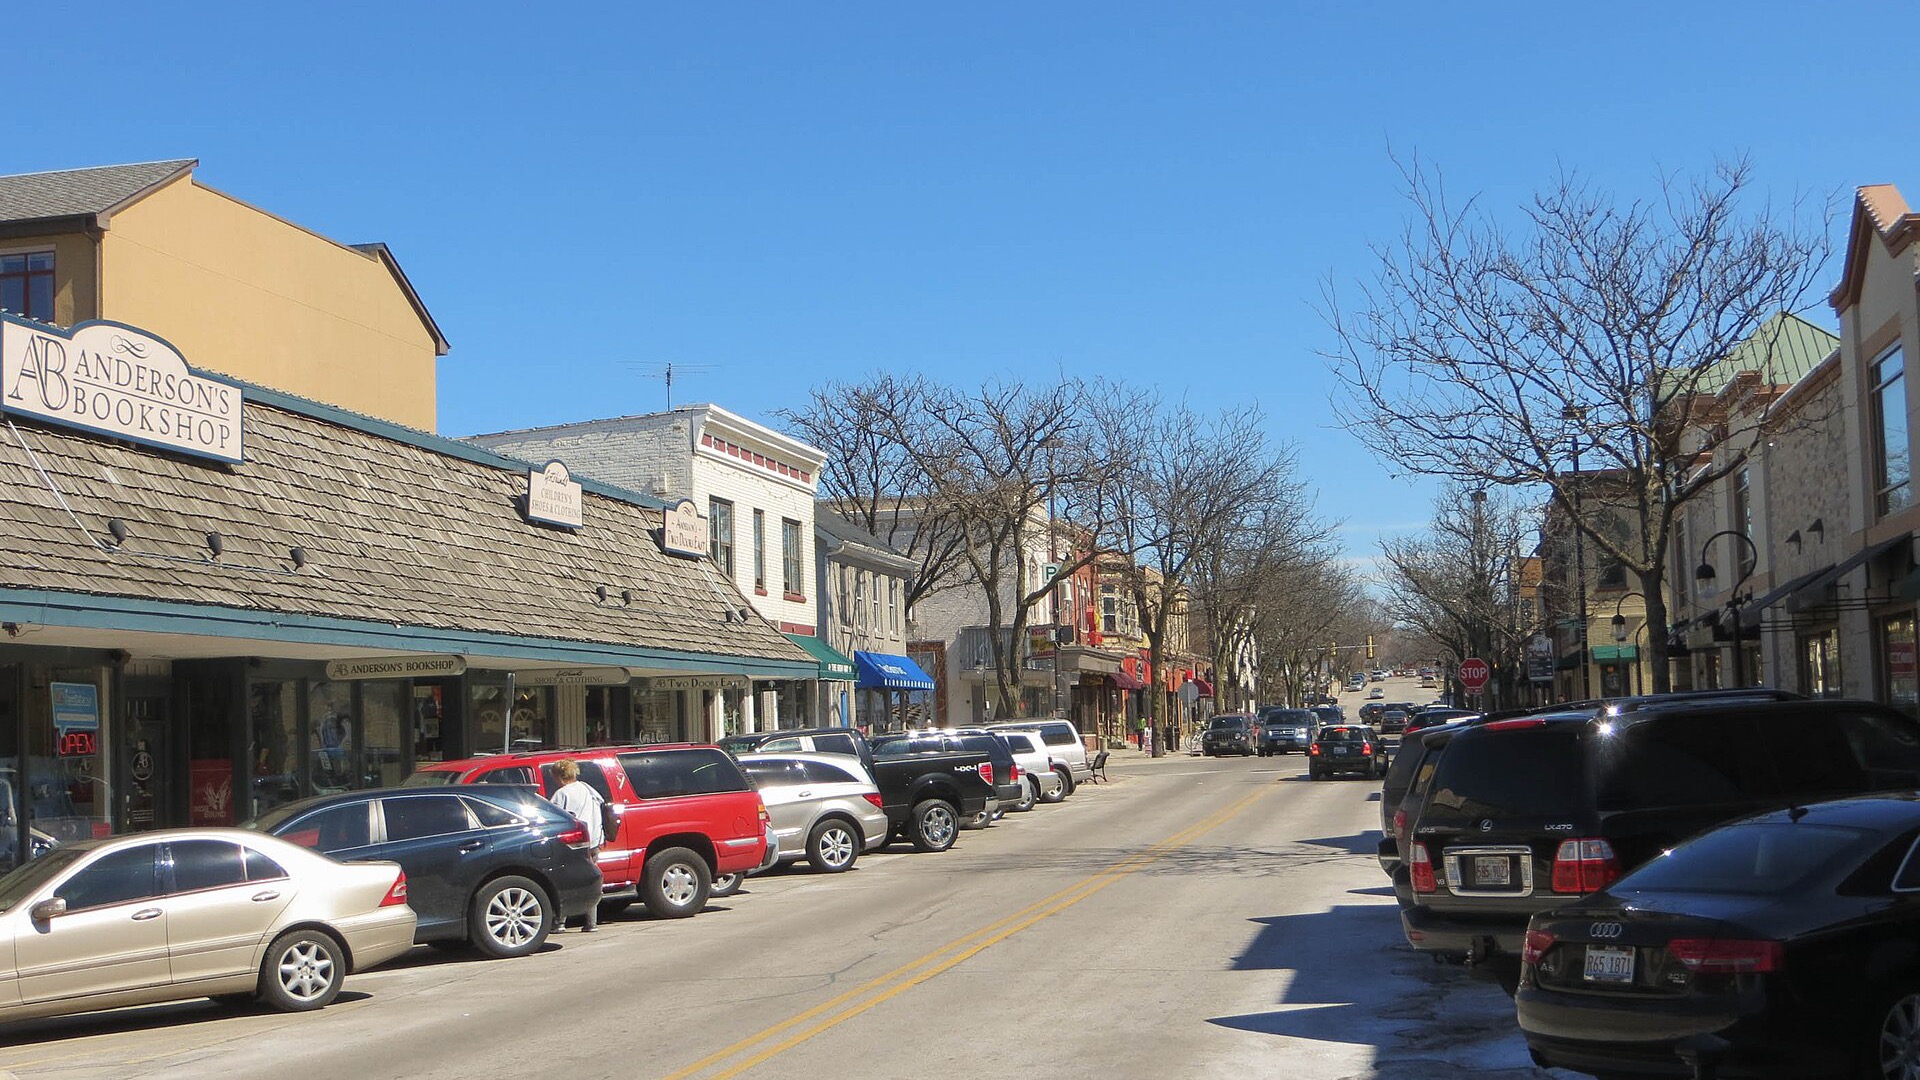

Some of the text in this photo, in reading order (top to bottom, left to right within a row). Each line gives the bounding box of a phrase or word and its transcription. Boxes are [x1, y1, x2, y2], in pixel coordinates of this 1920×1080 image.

[74, 349, 230, 415] ANDERSON'S
[73, 386, 231, 449] BOOKSHOP
[541, 487, 573, 504] CHILDREN'S
[531, 499, 549, 512] SHOES
[555, 504, 581, 519] CLOTHING
[1046, 566, 1057, 580] P
[351, 662, 402, 674] ANDERSON'S
[406, 660, 454, 671] BOOKSHOP
[1460, 667, 1487, 679] STOP
[566, 676, 603, 684] CLOTHING
[60, 733, 97, 755] OPEN
[1544, 823, 1573, 831] LX470
[1587, 955, 1632, 975] R65 1871
